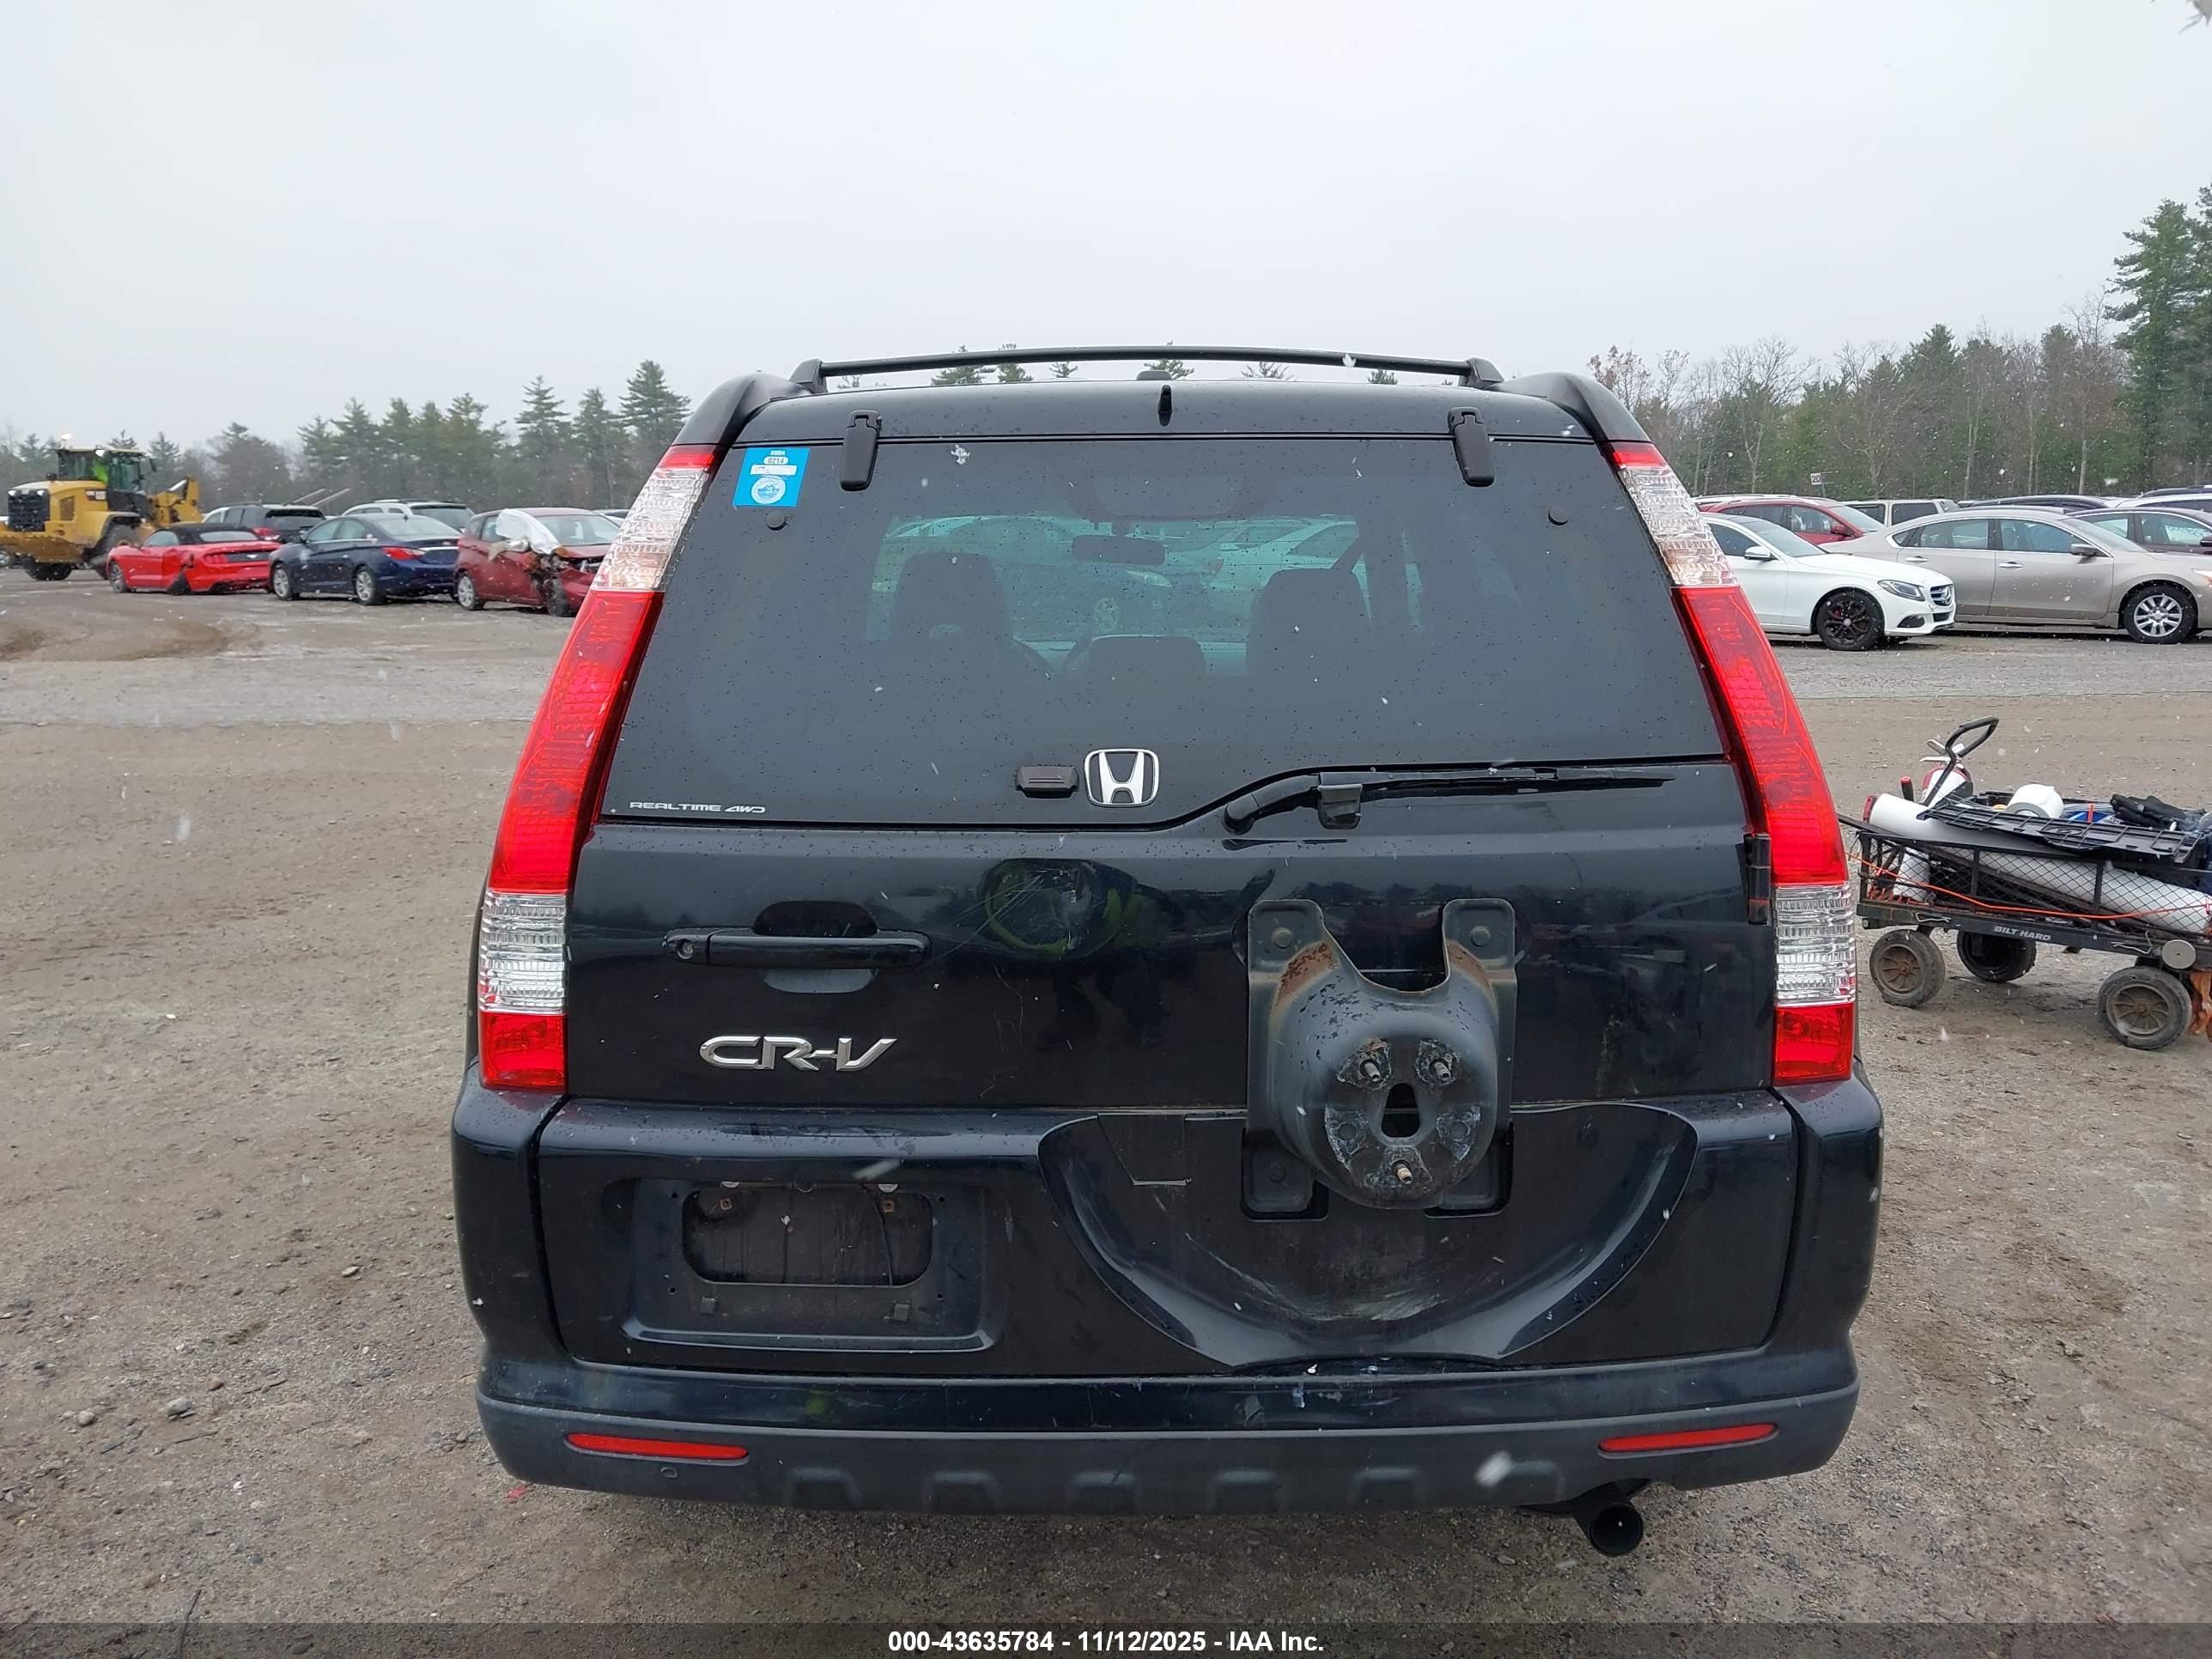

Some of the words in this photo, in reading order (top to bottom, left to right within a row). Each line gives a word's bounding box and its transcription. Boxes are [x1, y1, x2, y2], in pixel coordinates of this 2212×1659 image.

[629, 802, 721, 811] REALTIME
[1994, 926, 2019, 935] BILT
[2020, 930, 2051, 941] HARD
[700, 1036, 898, 1072] CR-V
